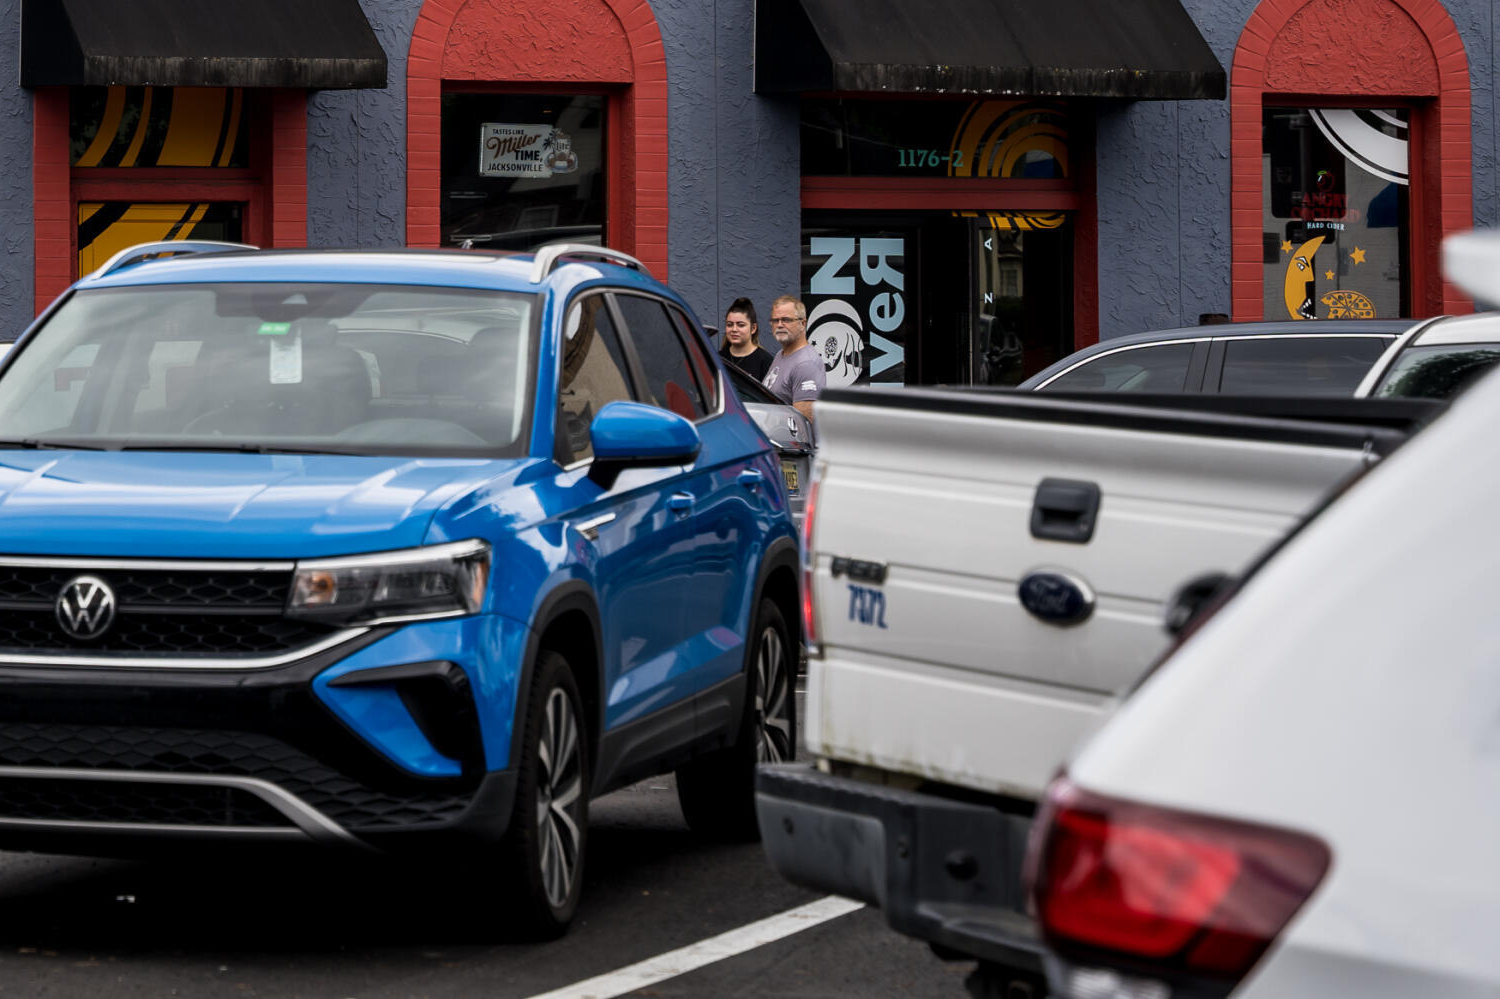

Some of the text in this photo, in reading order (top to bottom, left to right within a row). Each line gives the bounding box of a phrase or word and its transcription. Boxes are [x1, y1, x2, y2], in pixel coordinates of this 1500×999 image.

[486, 134, 541, 159] Miller
[488, 163, 543, 172] JACKSONVILLE
[898, 149, 964, 168] 1176-2
